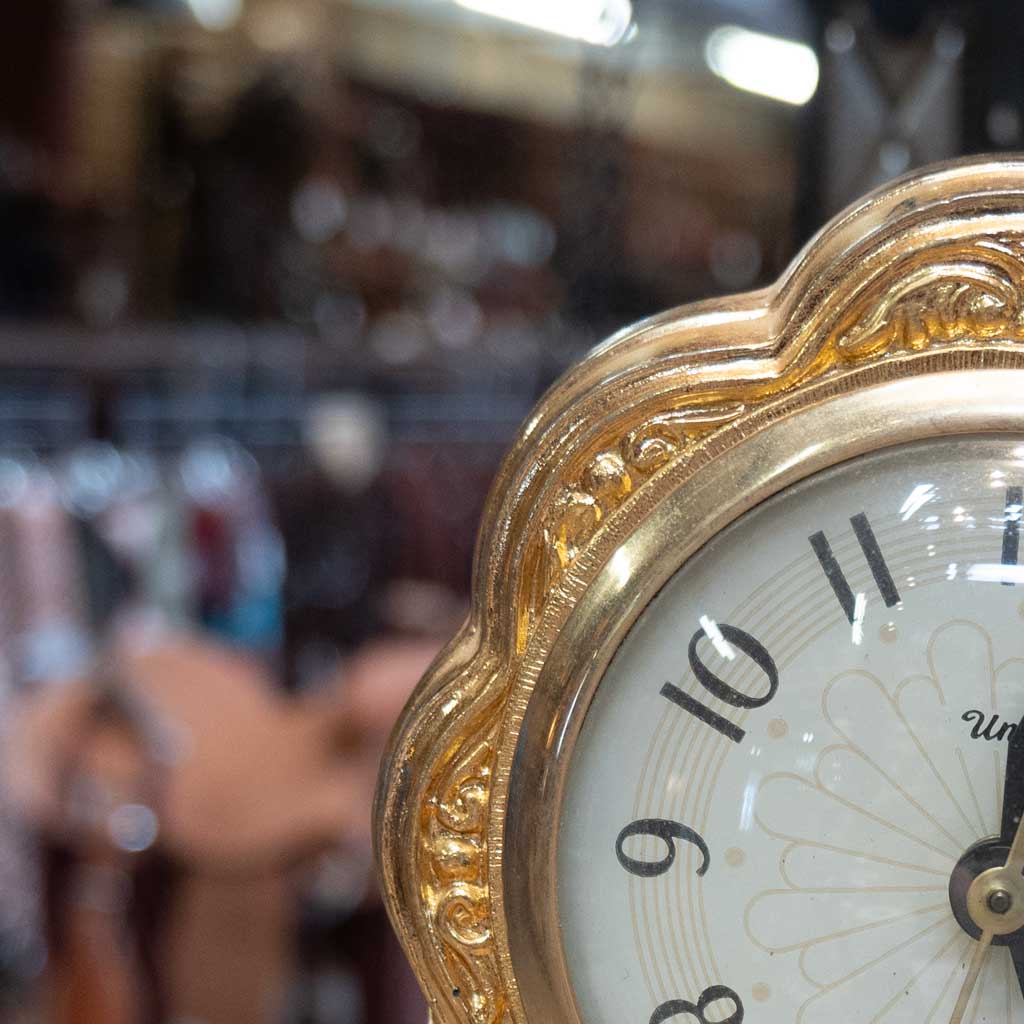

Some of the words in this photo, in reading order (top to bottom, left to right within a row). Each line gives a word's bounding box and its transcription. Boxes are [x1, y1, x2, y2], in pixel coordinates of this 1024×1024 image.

[808, 511, 901, 625] 11
[659, 623, 779, 744] 10
[614, 818, 711, 878] 9
